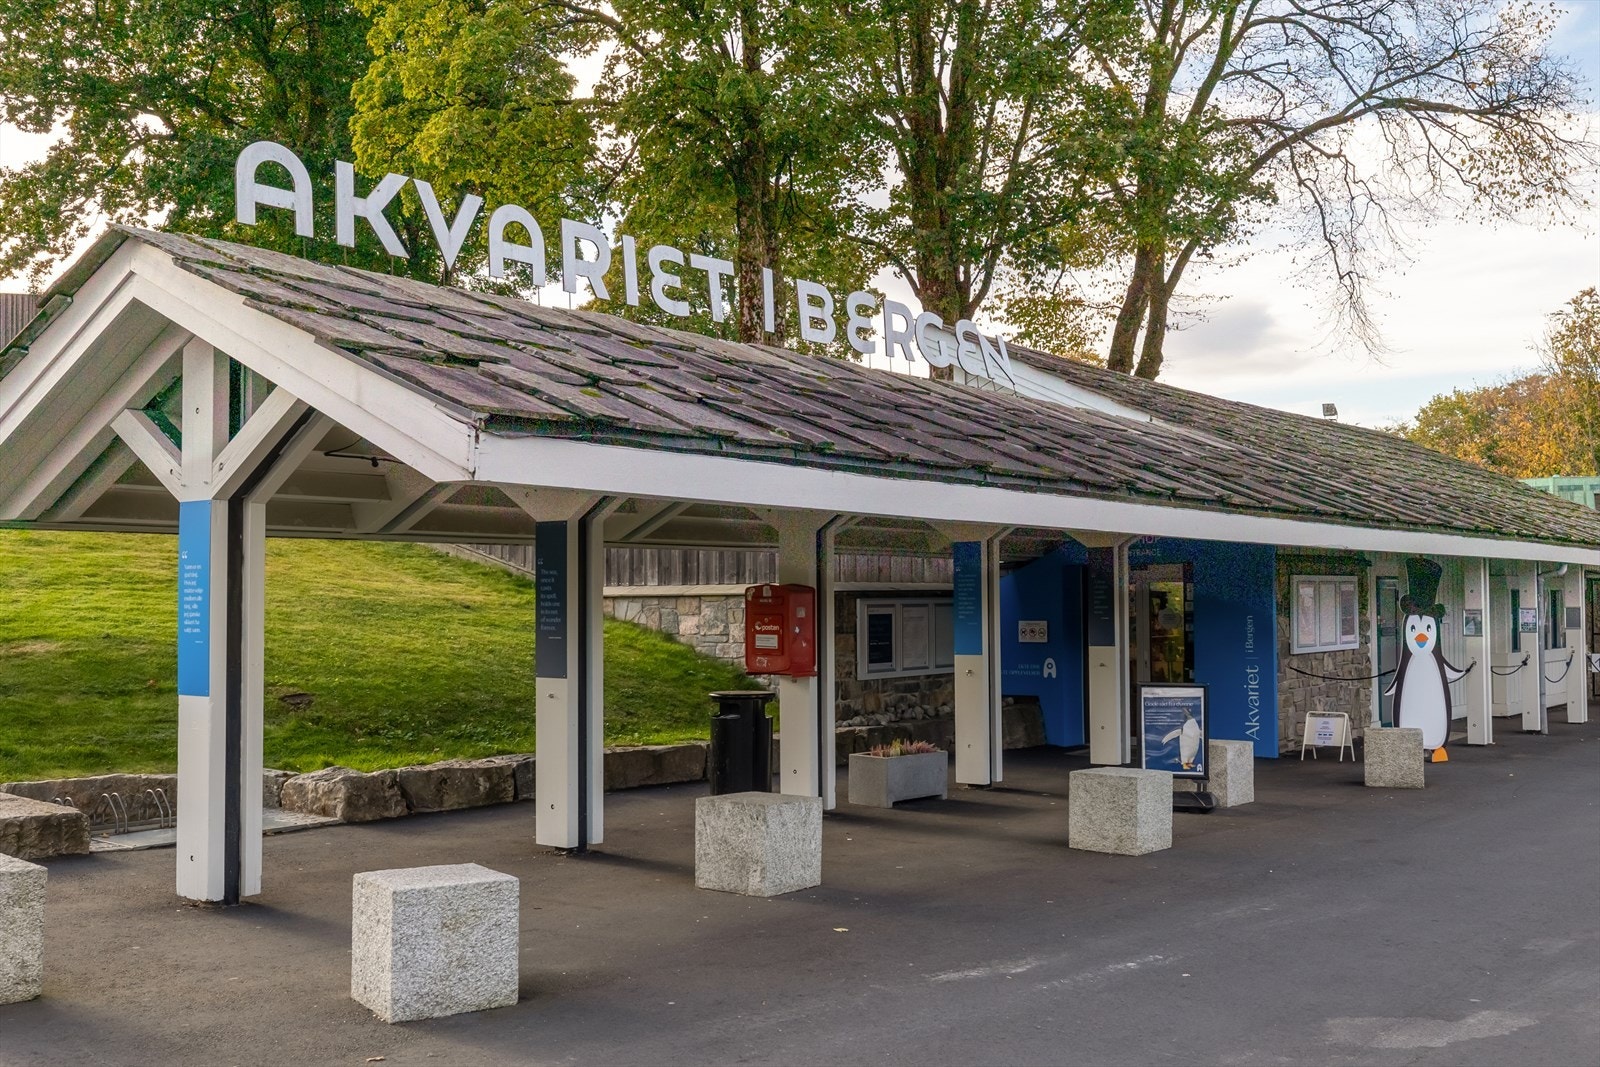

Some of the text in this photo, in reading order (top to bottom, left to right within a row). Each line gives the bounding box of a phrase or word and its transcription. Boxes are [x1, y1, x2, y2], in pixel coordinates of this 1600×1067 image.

[235, 141, 1016, 386] AKVARIET I BERGEN
[1245, 615, 1255, 649] Bergen
[1244, 664, 1260, 740] Akvariet
